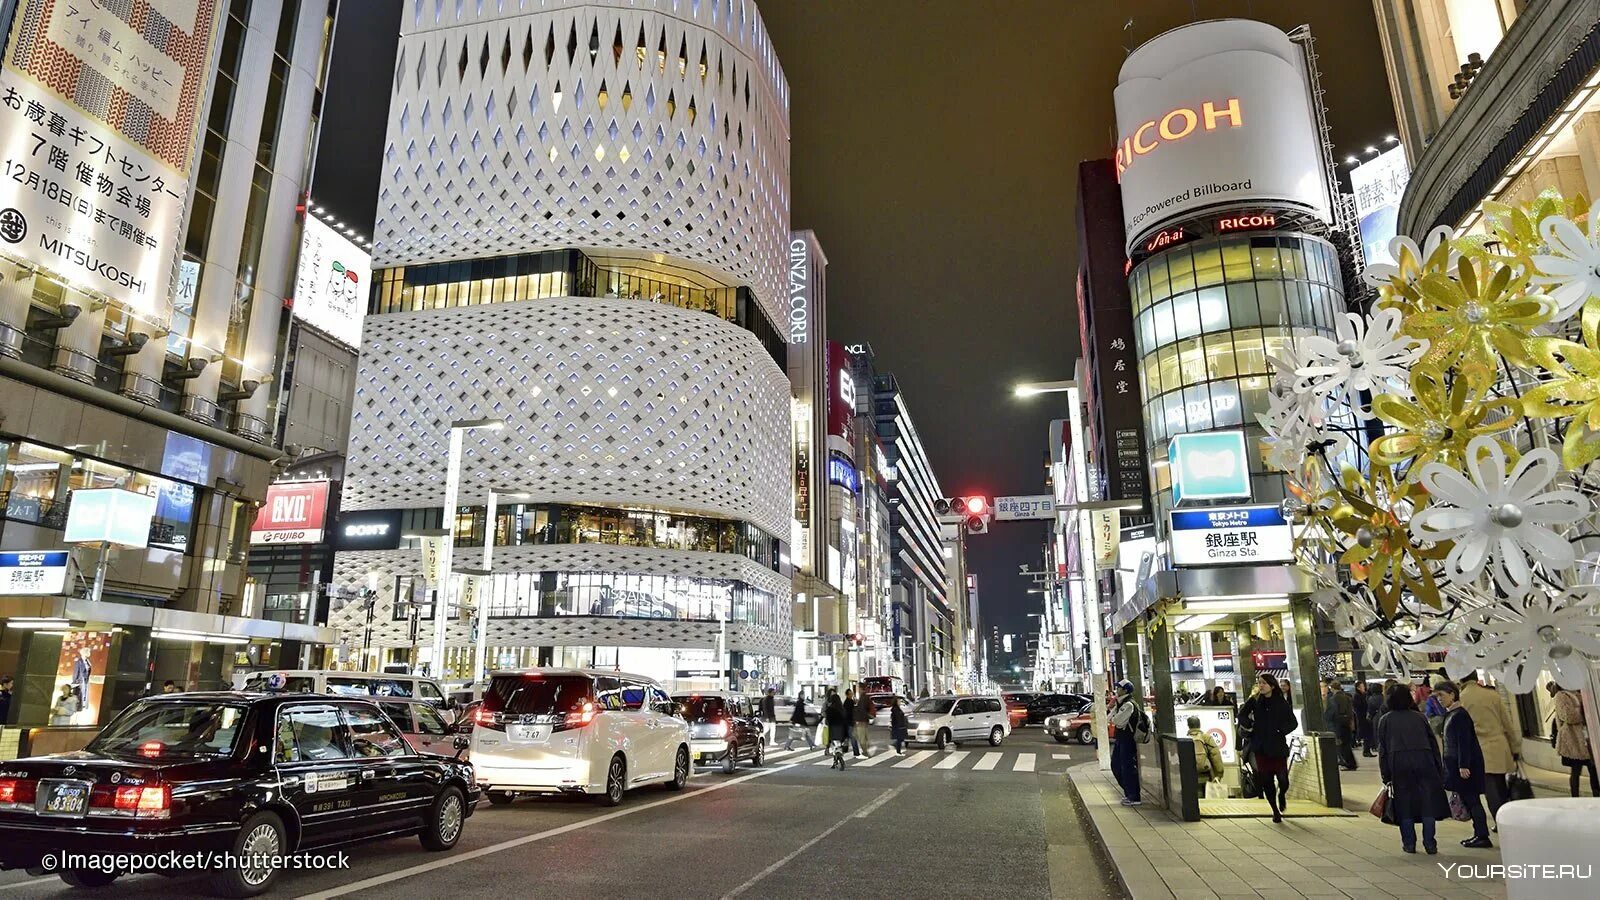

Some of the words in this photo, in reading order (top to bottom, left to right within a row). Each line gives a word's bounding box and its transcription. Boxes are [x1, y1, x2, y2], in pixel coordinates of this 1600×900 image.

[65, 4, 91, 29] アイ
[129, 54, 173, 87] ハッピー
[2, 86, 179, 200] お歳暮ギフトセンター
[1115, 97, 1243, 185] RICOH
[75, 160, 152, 219] 催物会場
[1133, 190, 1191, 228] Eco-Powered
[1193, 178, 1252, 198] Billboard
[1219, 216, 1276, 230] RICOH
[39, 233, 147, 295] MITSUKOSHI
[790, 238, 807, 294] GINZA
[790, 299, 807, 345] CORE
[845, 344, 866, 354] NCL
[1110, 337, 1128, 394] 鳩居堂
[998, 500, 1051, 512] 銀座四丁目
[1208, 511, 1249, 521] 東京メトロ
[1212, 520, 1229, 528] Tokyo
[273, 531, 306, 542] FUJIBO
[345, 524, 390, 537] SONY
[1205, 531, 1259, 548] 銀座駅
[1208, 548, 1237, 558] Ginza
[1239, 548, 1260, 557] Sta.
[337, 799, 352, 809] TAXI
